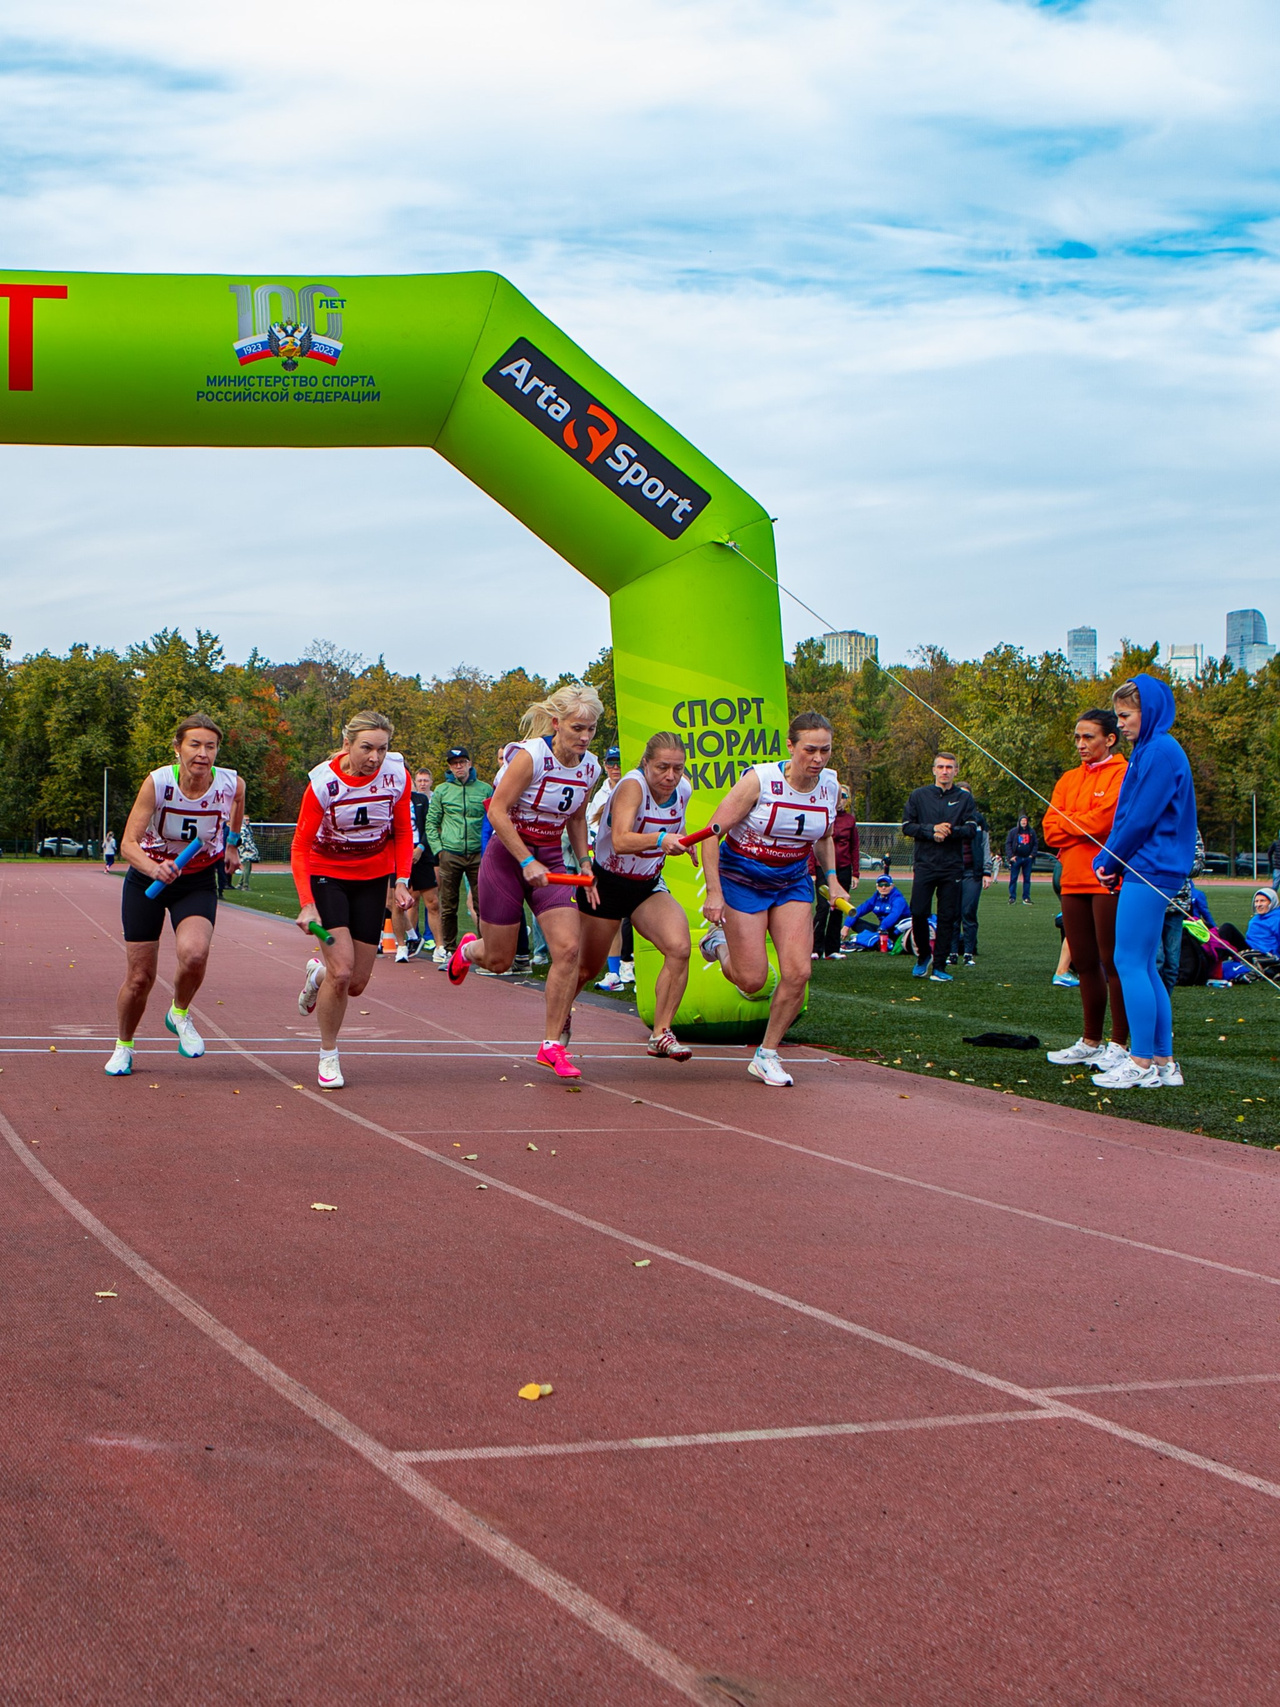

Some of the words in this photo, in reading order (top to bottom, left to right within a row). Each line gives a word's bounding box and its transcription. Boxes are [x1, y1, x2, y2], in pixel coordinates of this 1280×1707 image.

[318, 298, 347, 309] ЛЕТ
[242, 343, 263, 355] 1923
[313, 343, 335, 357] 2023
[206, 375, 318, 388] МИНИСТЕРСТВО
[322, 375, 376, 388] СПОРТА
[196, 388, 289, 402] РОССИЙСКОЙ
[293, 390, 381, 404] ФЕДЕРАЦИИ
[499, 357, 571, 422] Arta
[605, 443, 693, 524] Sport
[673, 697, 764, 728] СПОРТ
[679, 728, 781, 759] НОРМА
[558, 786, 574, 812] 3
[353, 807, 370, 825] 4
[795, 813, 805, 836] 1
[181, 818, 198, 840] 5
